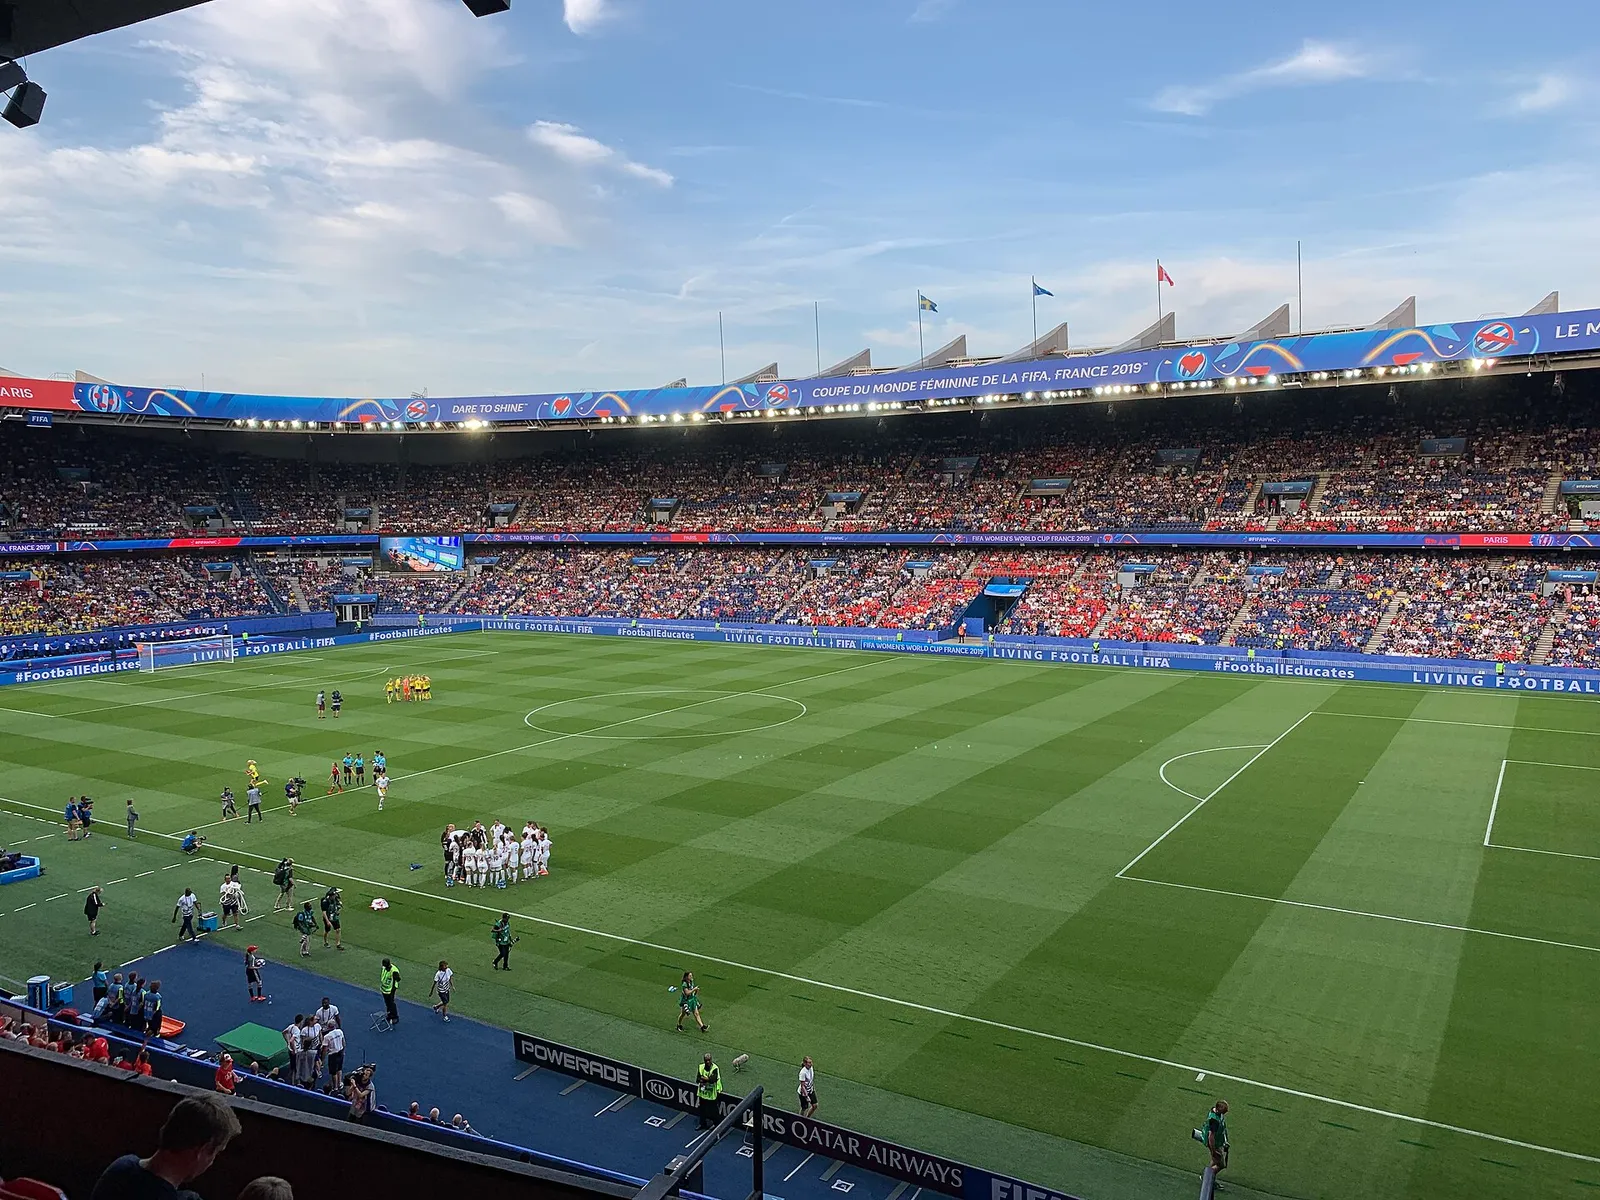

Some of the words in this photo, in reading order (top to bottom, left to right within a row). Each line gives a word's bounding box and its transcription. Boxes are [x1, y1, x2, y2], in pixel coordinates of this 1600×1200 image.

[1555, 324, 1580, 339] LE
[812, 386, 851, 398] COUPE
[853, 384, 871, 395] DU
[872, 380, 917, 394] MONDE
[919, 376, 979, 391] FÉMININE
[981, 375, 999, 386] DE
[1002, 373, 1018, 384] LA
[1021, 371, 1051, 383] FIFA,
[1054, 365, 1109, 380] FRANCE
[452, 405, 477, 414] DARE
[480, 404, 493, 413] TO
[31, 415, 48, 423] FIFA
[1483, 536, 1509, 544] PARIS
[369, 626, 452, 641] #FootballEducates
[487, 621, 521, 630] LIVING
[578, 625, 593, 634] FIFA
[617, 628, 695, 640] #FootballEducates
[725, 633, 763, 643] LIVING
[836, 639, 856, 649] FIFA
[863, 641, 876, 649] FIFA
[906, 644, 929, 652] WORLD
[930, 645, 943, 653] CUP
[193, 648, 239, 662] LIVING
[316, 637, 335, 647] FIFA
[993, 648, 1043, 660] LIVING
[1142, 657, 1170, 668] FIFA
[16, 660, 141, 682] #FootballEducates
[1214, 661, 1355, 679] #FootballEducates
[1412, 672, 1483, 686] LIVING
[1495, 676, 1600, 693] FOOTBAL
[521, 1039, 630, 1087] POWERADE
[650, 1081, 670, 1098] KIA
[791, 1120, 862, 1158] QATAR
[867, 1144, 963, 1188] AIRWAYS
